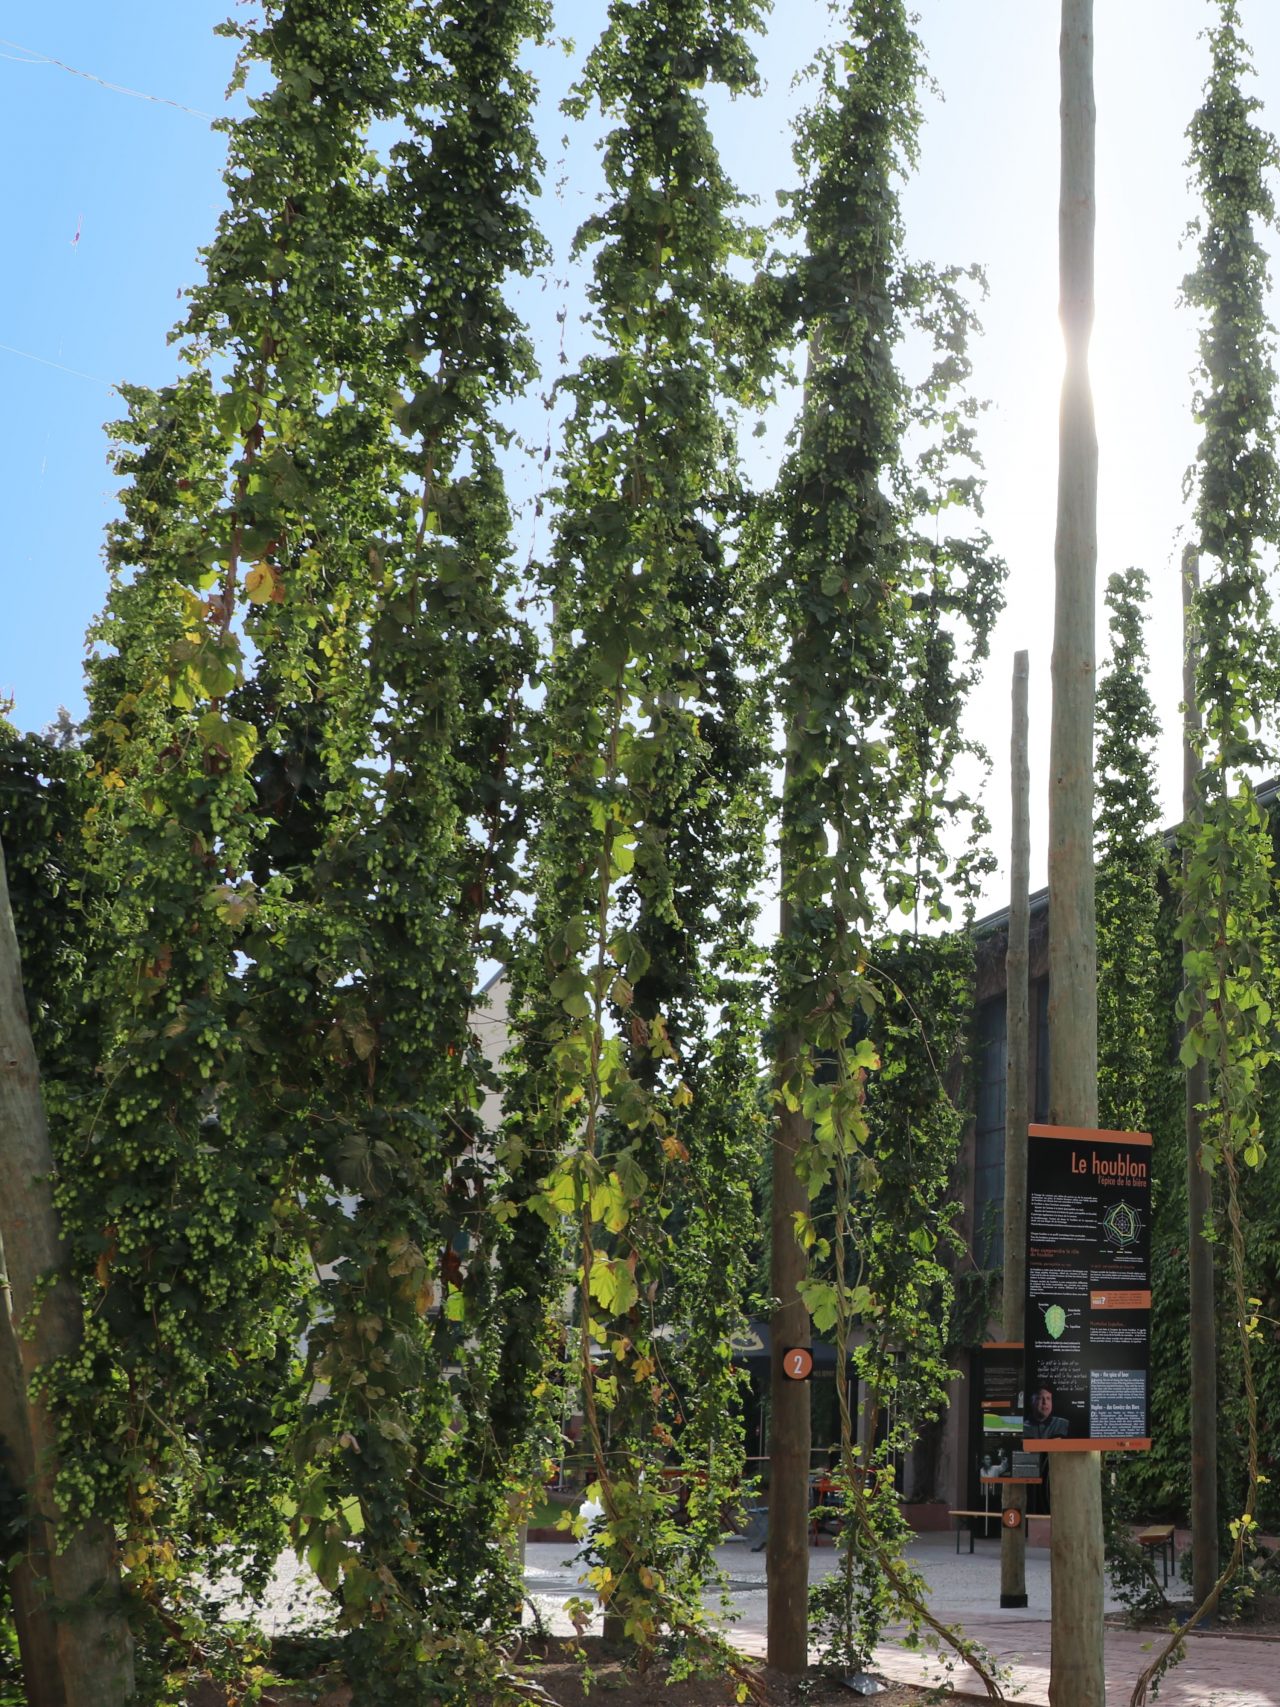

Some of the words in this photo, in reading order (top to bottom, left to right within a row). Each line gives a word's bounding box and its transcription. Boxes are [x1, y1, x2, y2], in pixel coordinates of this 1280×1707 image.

[1071, 1151, 1087, 1175] Le
[1092, 1151, 1147, 1178] houblon
[1117, 1176, 1125, 1186] de
[1125, 1177, 1131, 1186] la
[794, 1355, 803, 1374] 2
[1008, 1512, 1015, 1524] 3
